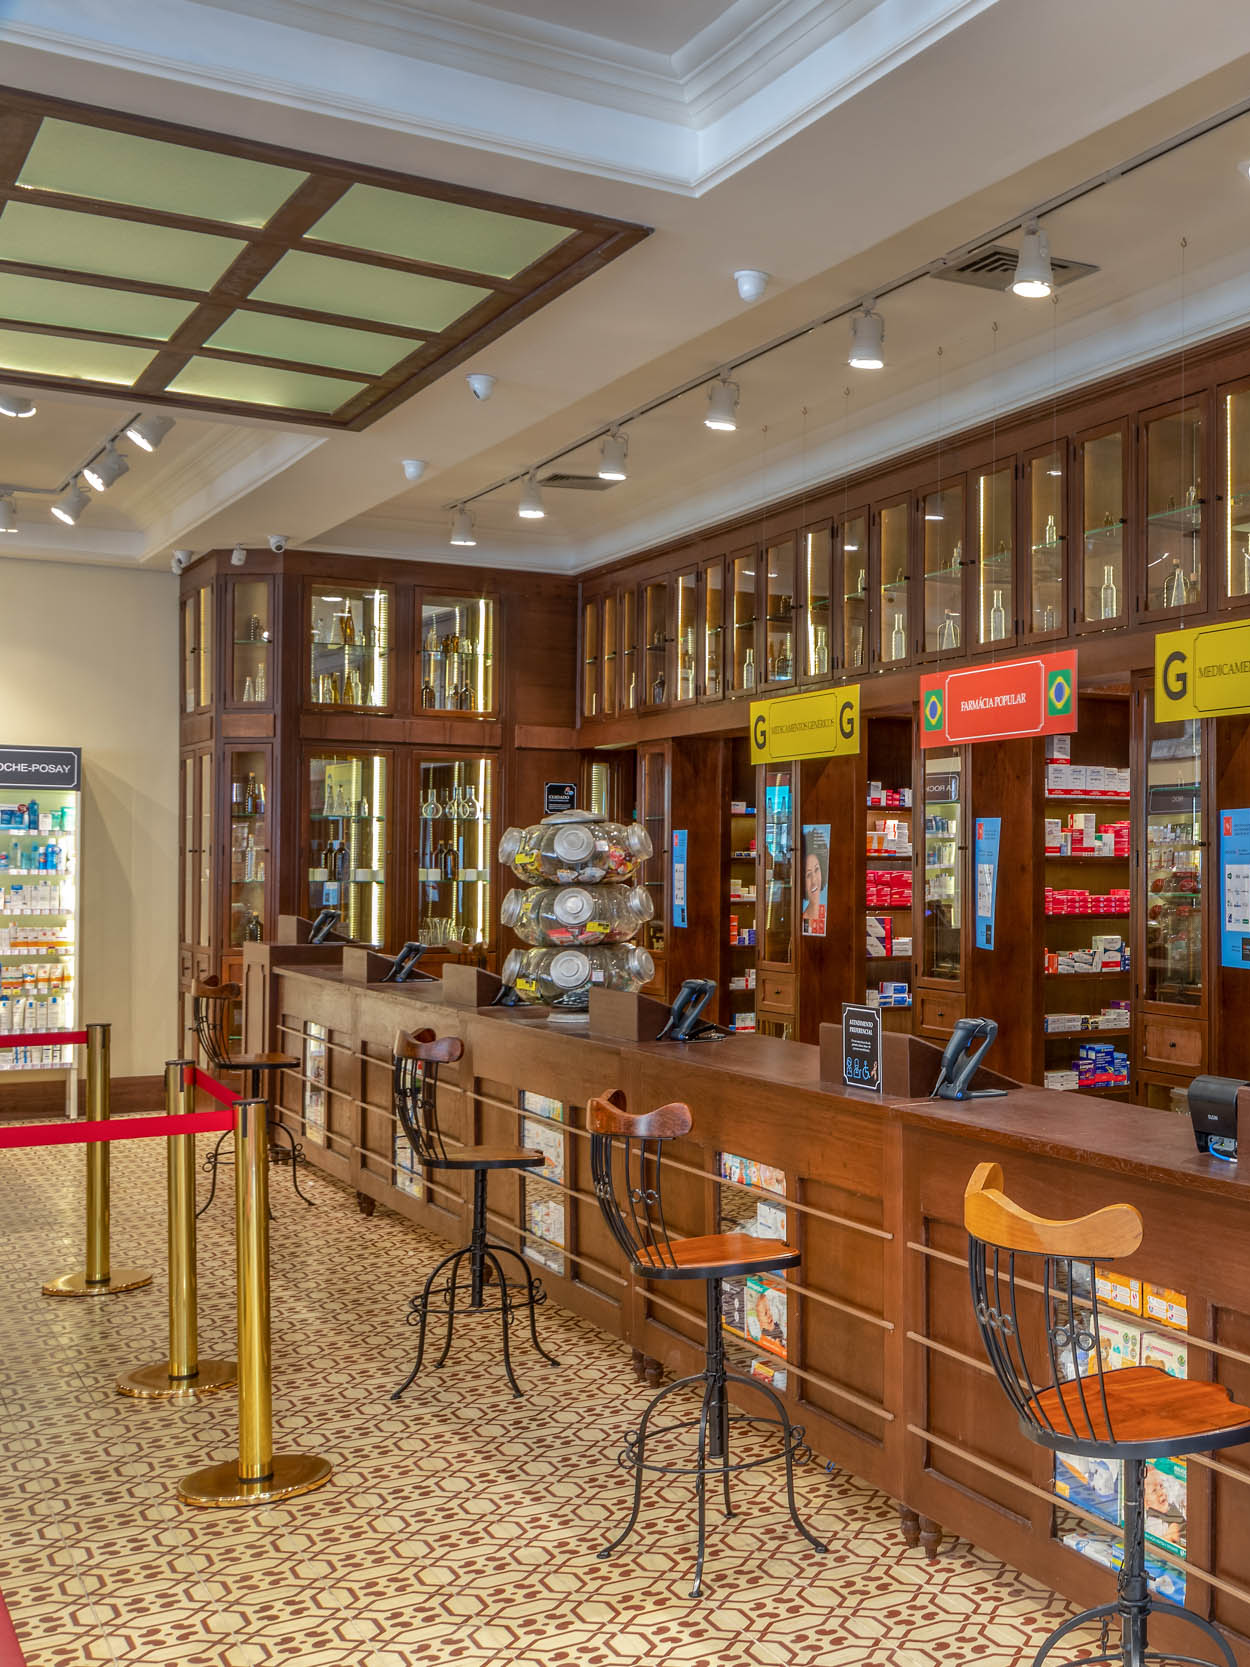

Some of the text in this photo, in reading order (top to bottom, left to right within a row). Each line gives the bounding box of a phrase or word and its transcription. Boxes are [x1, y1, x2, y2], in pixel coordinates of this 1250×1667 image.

[1163, 651, 1188, 700] G
[839, 701, 854, 739] G
[960, 692, 1026, 712] FARMÁCIA POPULAR
[754, 714, 766, 750] G
